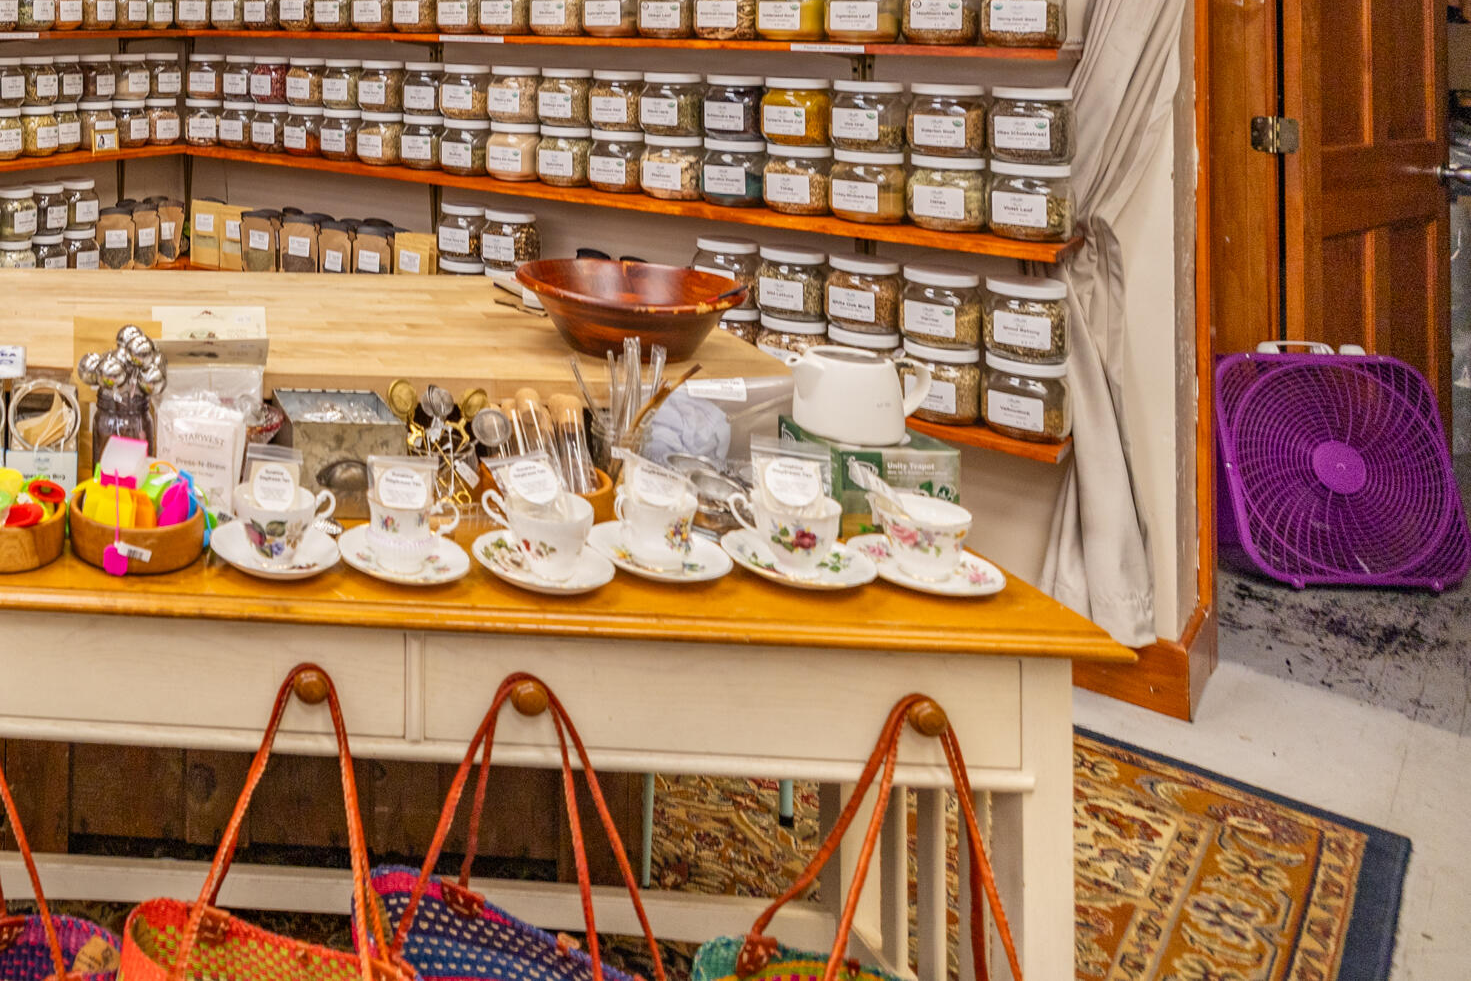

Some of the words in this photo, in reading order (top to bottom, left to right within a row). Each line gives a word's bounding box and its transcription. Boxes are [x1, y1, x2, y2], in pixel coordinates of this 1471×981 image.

[177, 434, 225, 445] STARWEST
[887, 462, 907, 471] Unity
[910, 462, 935, 471] Teapot
